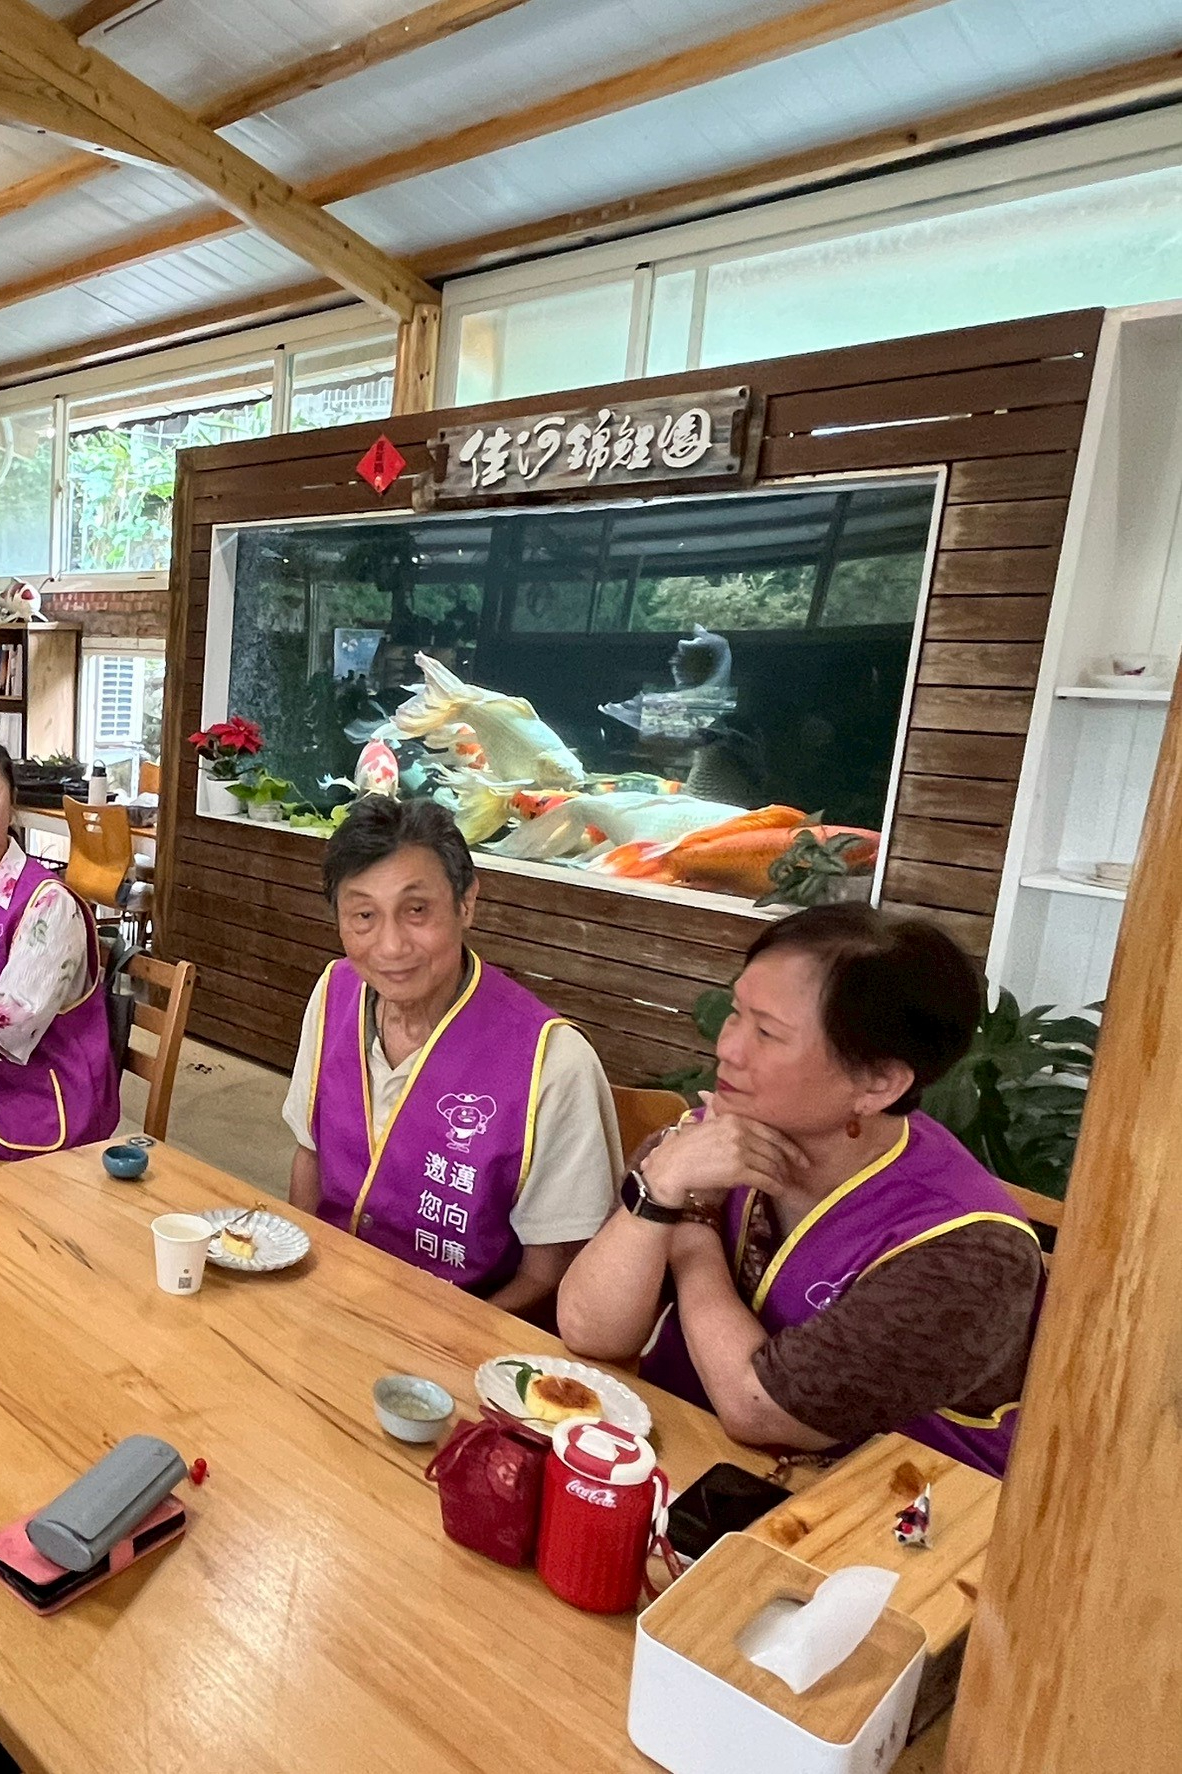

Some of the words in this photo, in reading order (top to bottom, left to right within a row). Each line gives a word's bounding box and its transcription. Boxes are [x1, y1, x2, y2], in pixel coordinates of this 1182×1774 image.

[459, 408, 713, 488] 佳河錦鯉園
[415, 1151, 448, 1268] 邀您同
[441, 1161, 477, 1284] 邁向廉
